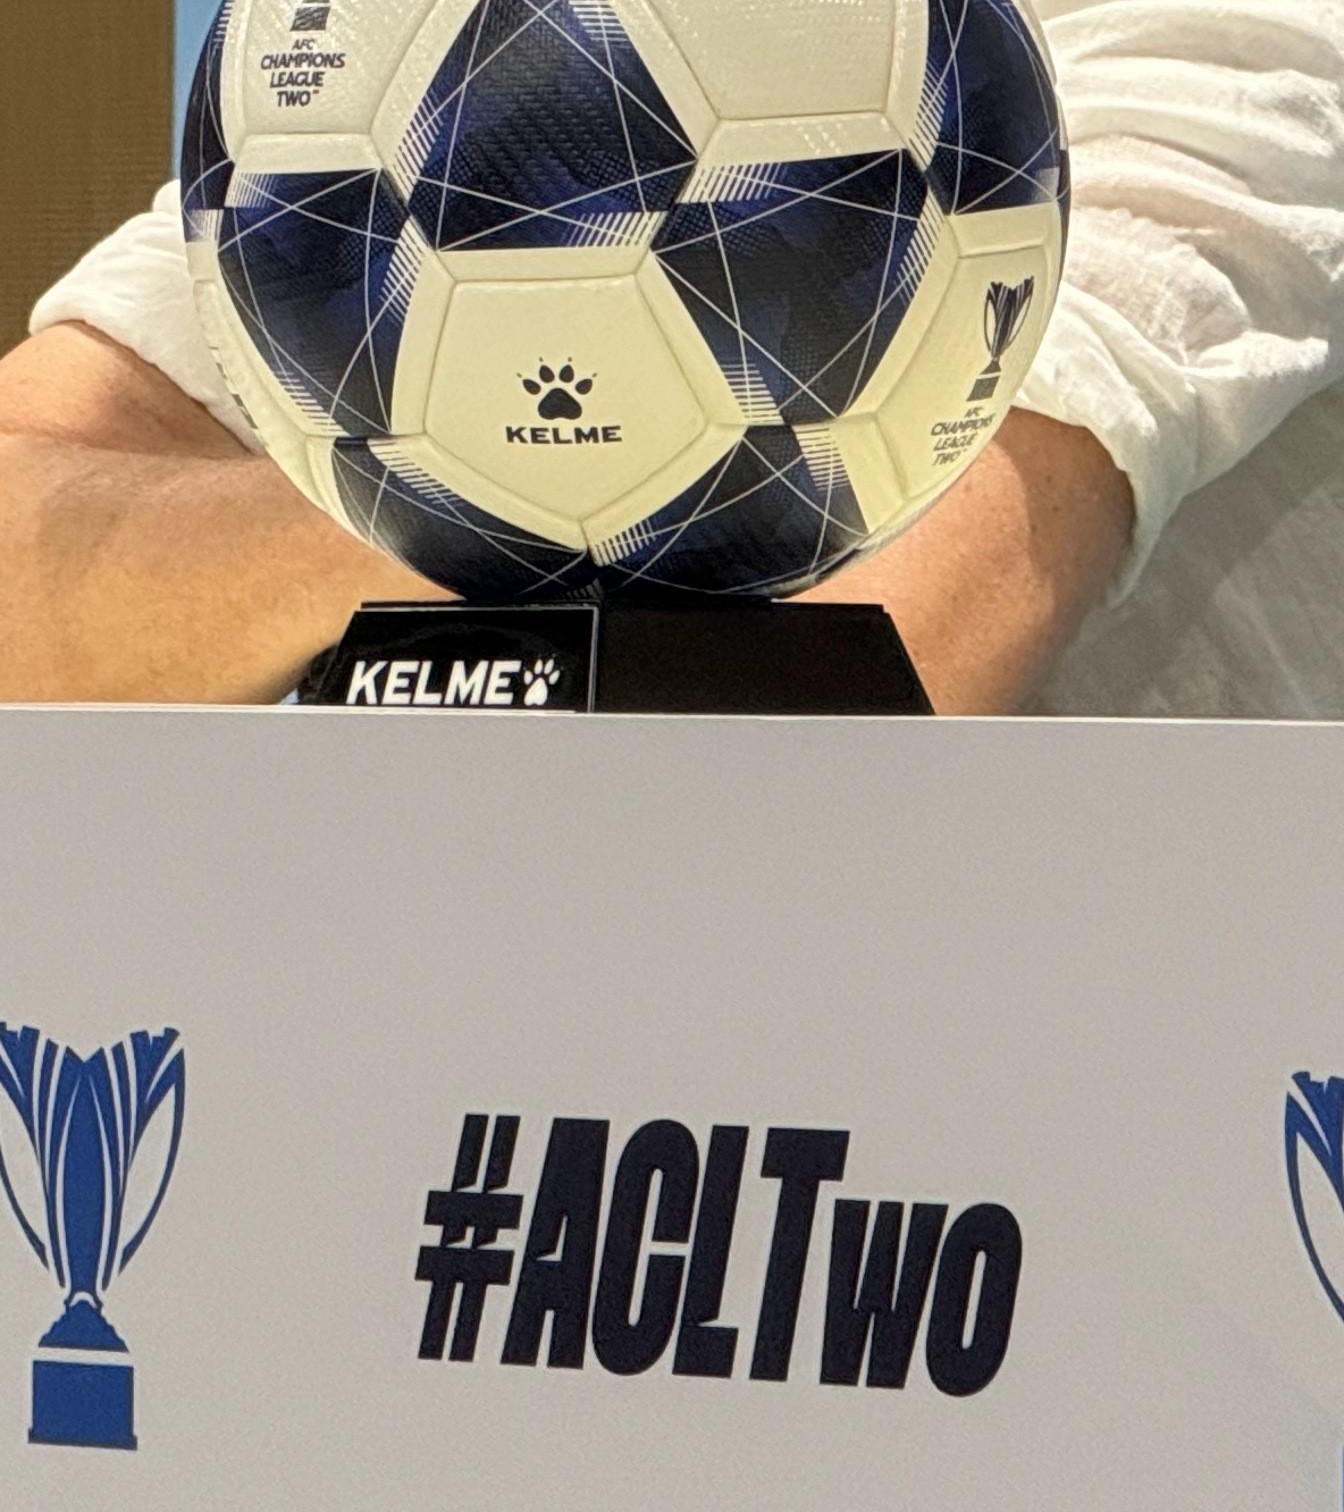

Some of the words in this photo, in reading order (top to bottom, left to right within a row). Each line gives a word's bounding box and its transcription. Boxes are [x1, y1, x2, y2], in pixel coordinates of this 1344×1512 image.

[292, 39, 316, 50] AFC
[260, 52, 346, 70] CHAMPIONS
[270, 71, 325, 89] LEAGUE
[505, 425, 623, 444] KELME
[345, 660, 523, 705] KELME
